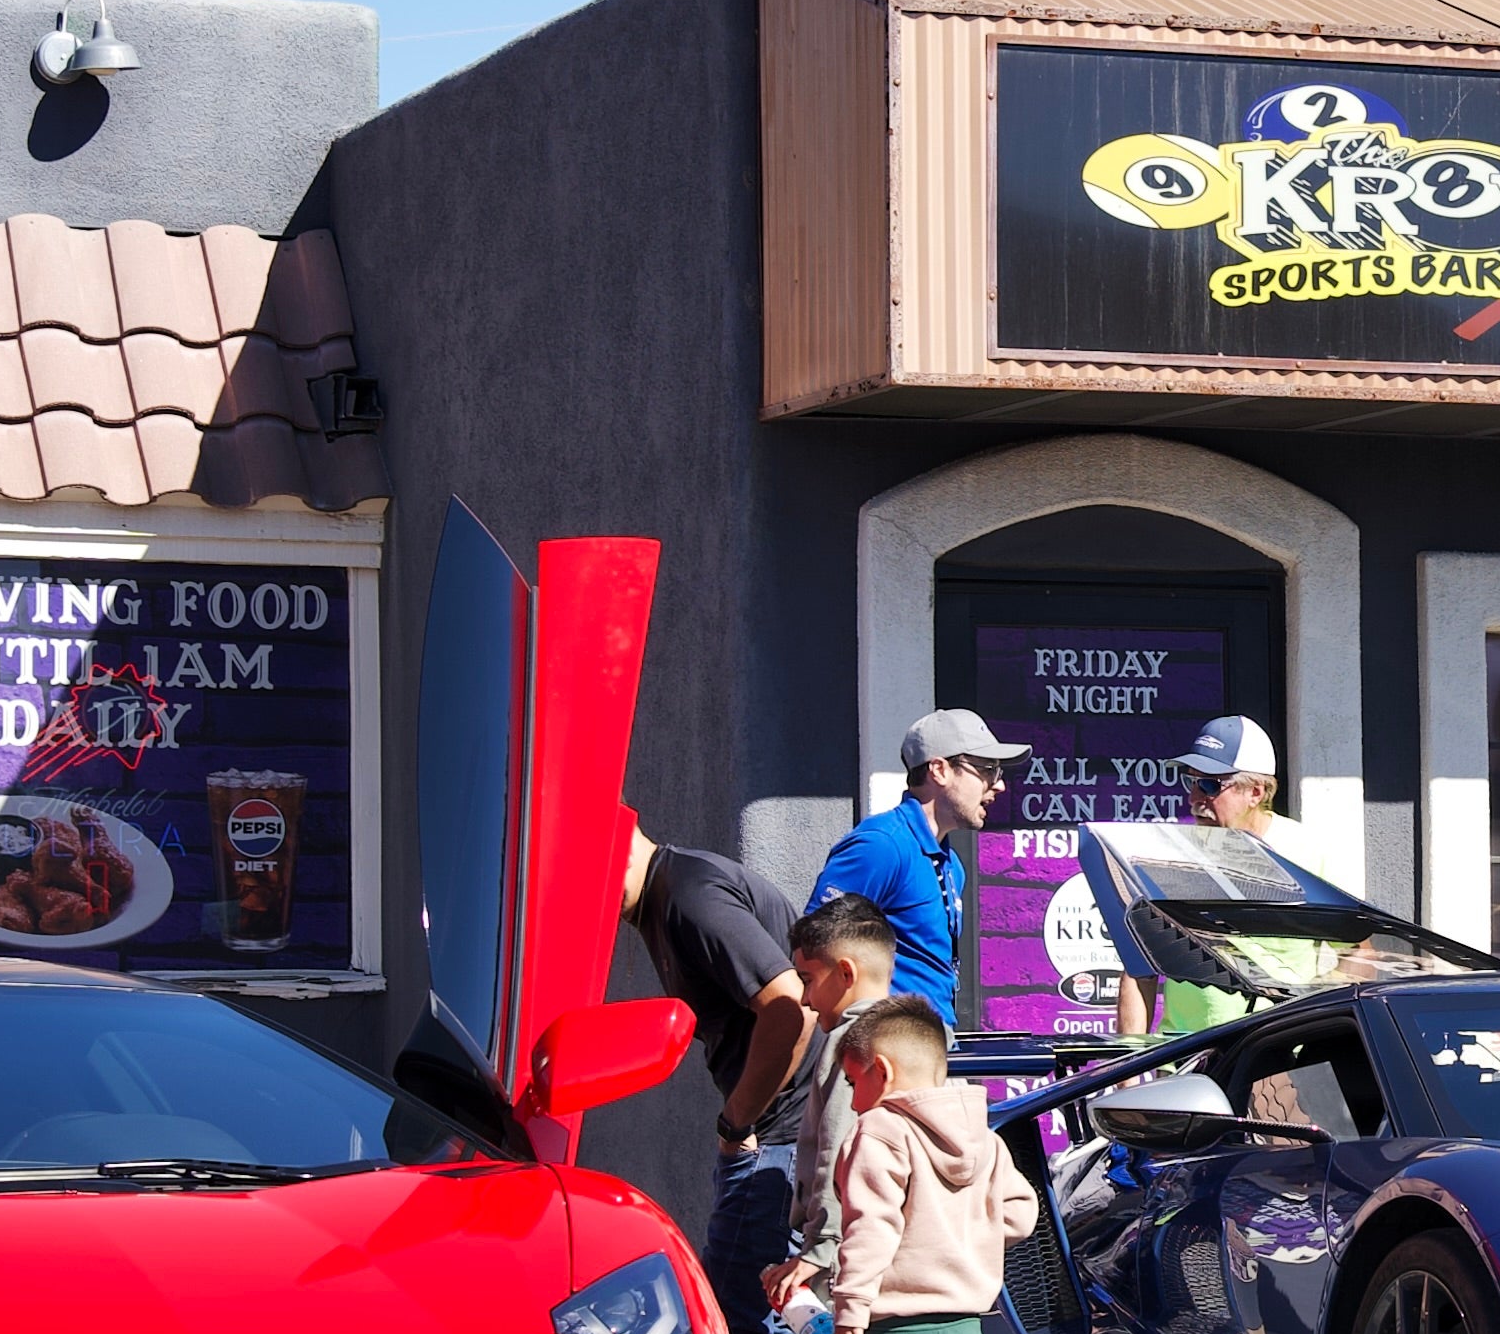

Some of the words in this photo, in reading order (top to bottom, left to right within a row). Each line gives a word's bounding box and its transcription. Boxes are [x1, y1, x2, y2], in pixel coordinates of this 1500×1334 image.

[1222, 253, 1397, 302] SPORTS
[170, 579, 329, 631] FOOD
[143, 642, 274, 690] 1AM
[1034, 648, 1169, 679] FRIDAY
[1046, 685, 1159, 715] NIGHT
[1023, 758, 1099, 787] ALL
[1111, 757, 1181, 787] YOU
[1021, 794, 1096, 823] CAN
[1113, 794, 1184, 823] EAT
[230, 820, 282, 838] PEPSI
[234, 860, 278, 873] DIET
[1053, 1017, 1105, 1034] Open
